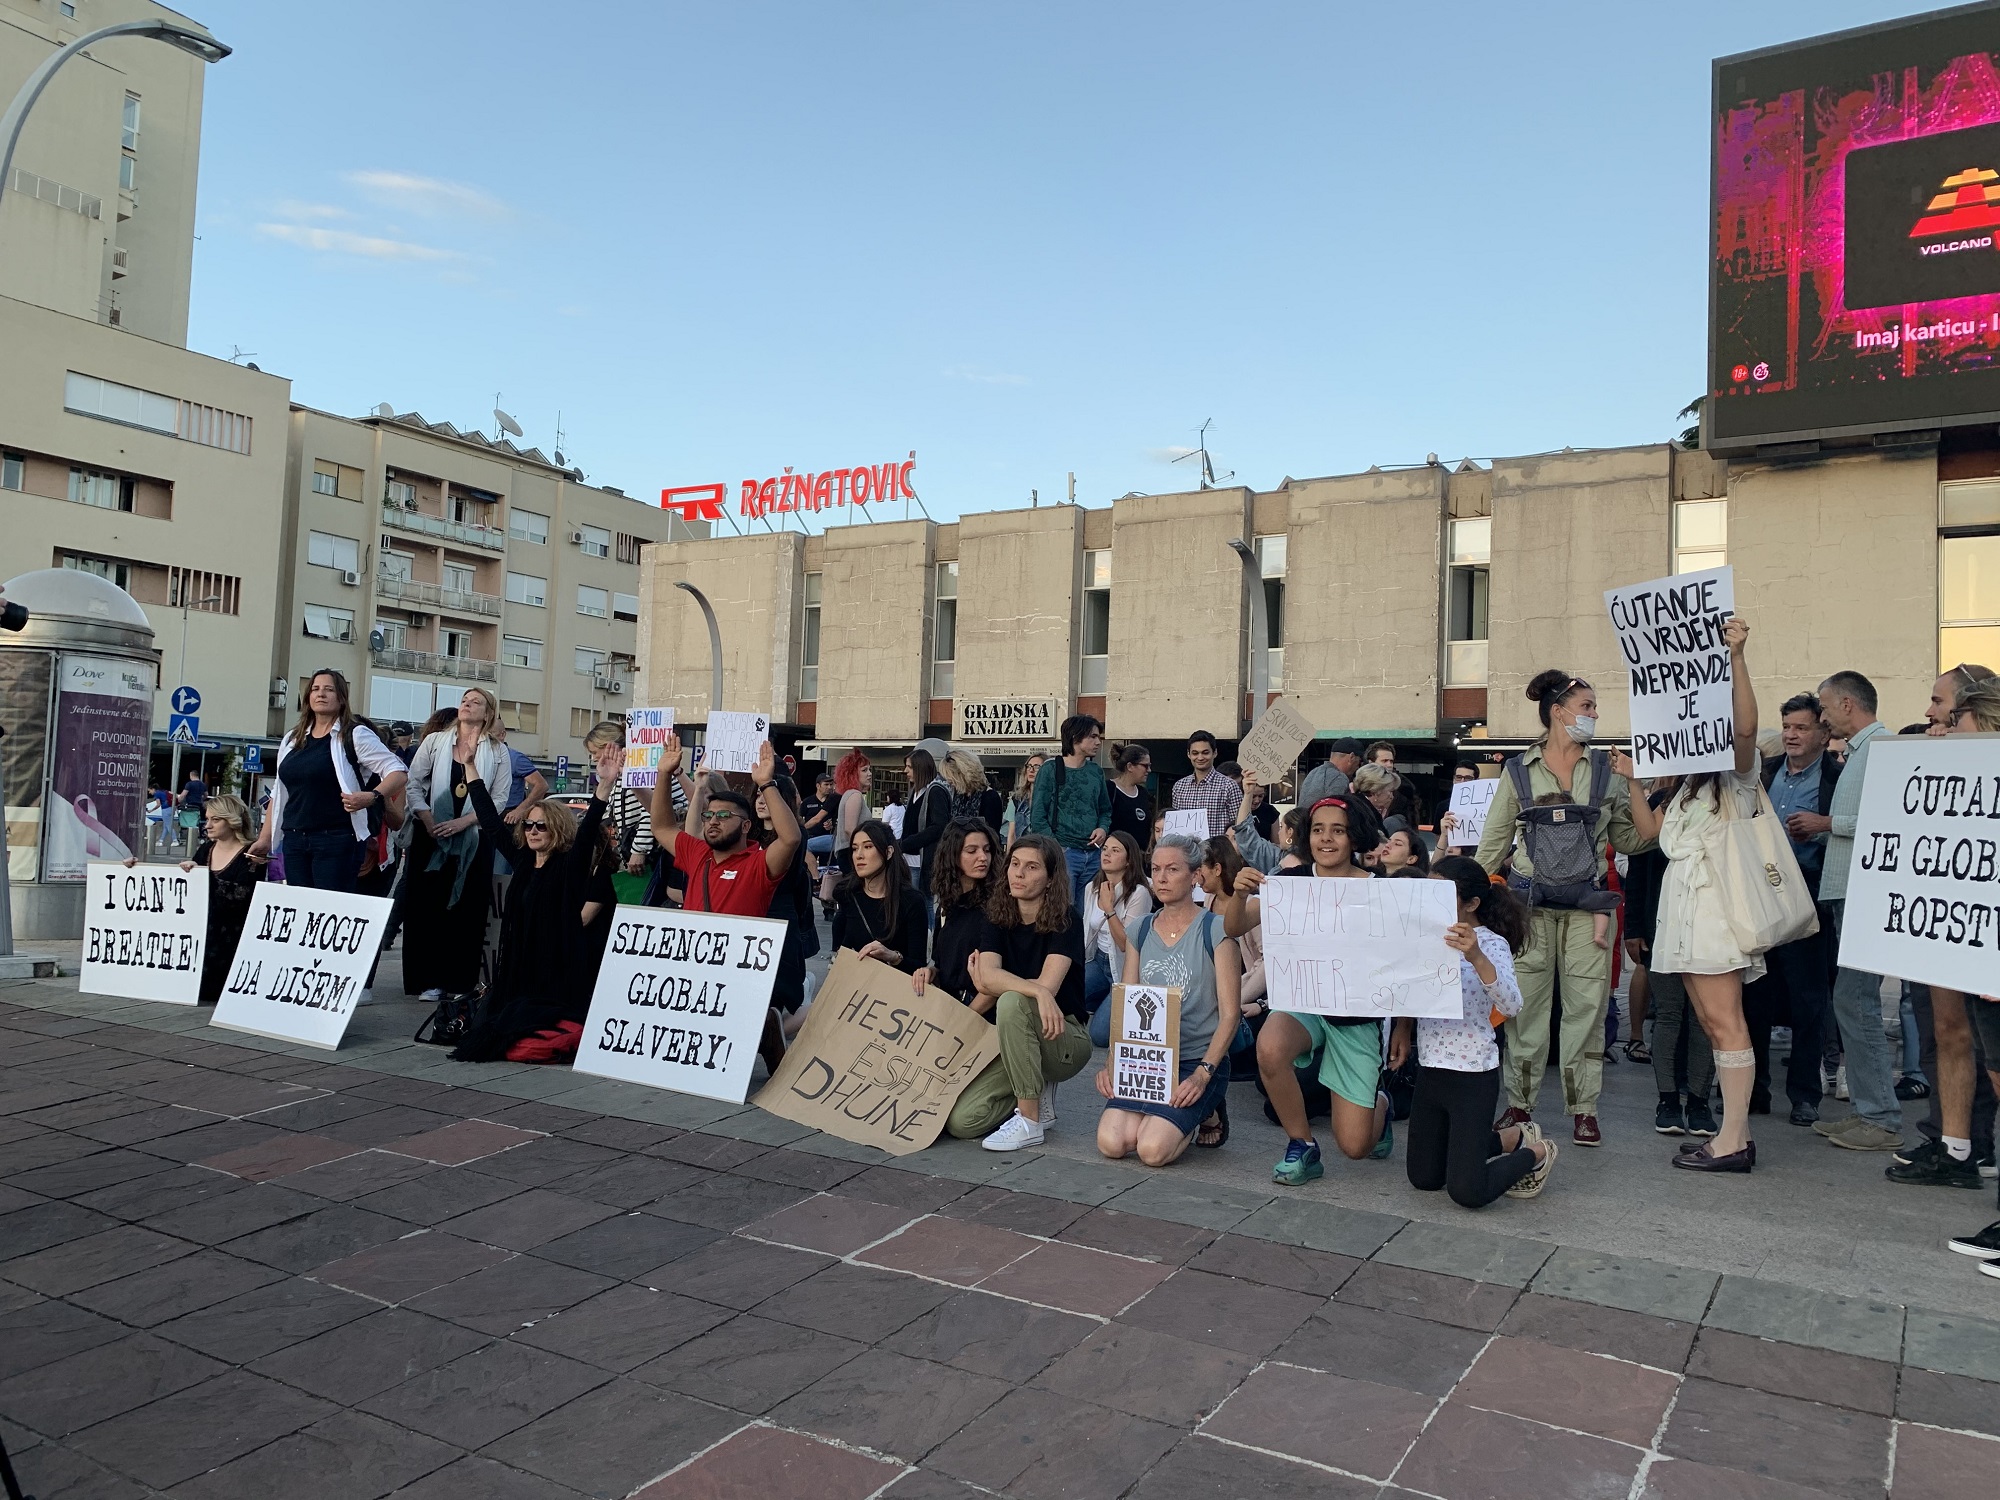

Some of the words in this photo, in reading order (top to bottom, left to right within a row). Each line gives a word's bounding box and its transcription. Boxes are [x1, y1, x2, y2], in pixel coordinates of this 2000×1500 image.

[1920, 237, 1992, 255] VOLCANO
[1856, 325, 1900, 348] Imaj
[1905, 318, 1975, 341] karticu
[1993, 312, 2000, 331] I
[1734, 368, 1747, 379] 18+
[740, 450, 916, 519] RAŽNATOVIĆ
[1611, 579, 1719, 631] ĆUTANJE
[1620, 634, 1641, 665] U
[72, 665, 105, 679] Dove
[1631, 650, 1730, 697] NEPRAVDE
[70, 704, 120, 717] Jedinstvene
[964, 703, 1049, 718] GRADSKA
[1677, 690, 1700, 721] JE
[633, 711, 642, 726] IF
[644, 711, 662, 727] YOU
[720, 712, 755, 731] RACISM
[964, 718, 1048, 735] KNJIŽARA
[1265, 708, 1291, 730] SKIN
[1286, 722, 1308, 746] COLOR
[92, 731, 136, 745] POVODOM
[1257, 723, 1267, 734] IS
[1264, 728, 1284, 745] NOT
[1633, 717, 1734, 765] PRIVILEGIJA
[248, 747, 257, 760] P
[558, 757, 566, 769] P
[627, 747, 649, 767] HURT
[1249, 732, 1288, 773] REASONABLE
[107, 779, 126, 787] borbu
[1460, 782, 1495, 806] BLA
[1451, 819, 1486, 840] MA
[1862, 832, 1900, 872] JE
[1912, 835, 2000, 884] GLOB
[104, 874, 116, 910] I
[124, 875, 188, 915] CAN'T
[1266, 878, 1346, 936] BLACK
[1366, 879, 1454, 938] LIVES
[256, 904, 297, 944] NE
[299, 911, 370, 955] MOGU
[86, 927, 199, 973] BREATHE!
[612, 922, 730, 966] SILENCE
[736, 935, 774, 972] IS
[228, 959, 263, 995] DA
[265, 958, 357, 1015] DIŠEM!
[627, 972, 727, 1017] GLOBAL
[1271, 956, 1348, 1010] MATTER
[598, 1017, 733, 1073] SLAVERY!
[1128, 1030, 1162, 1042] B.L.M.
[1120, 1046, 1166, 1062] BLACK
[1119, 1059, 1167, 1076] TRANS
[1118, 1086, 1166, 1101] MATTER
[1119, 1072, 1166, 1091] LIVES
[790, 1055, 938, 1142] DHUNË
